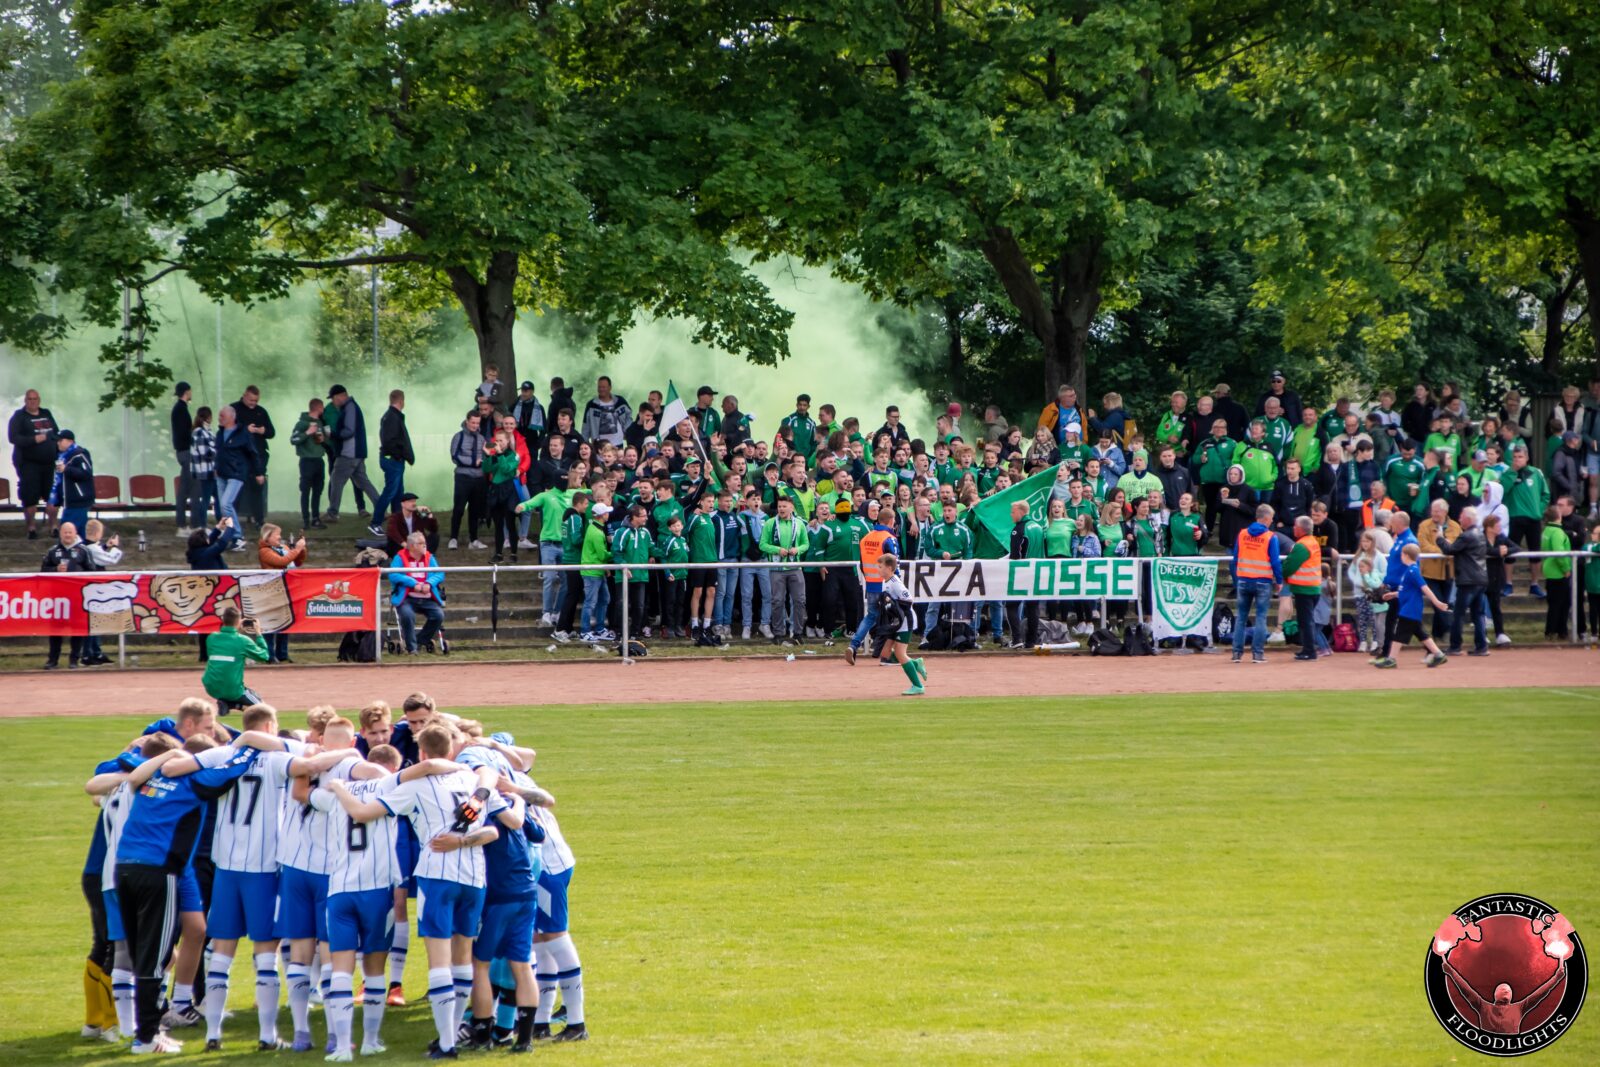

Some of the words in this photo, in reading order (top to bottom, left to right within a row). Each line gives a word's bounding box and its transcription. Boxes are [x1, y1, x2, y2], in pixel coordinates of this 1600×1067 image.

[1007, 559, 1134, 597] COSSE
[1160, 563, 1206, 577] DRESDEN
[1162, 580, 1202, 603] TSV
[307, 601, 362, 615] Feldschlößchen
[227, 775, 263, 827] 17
